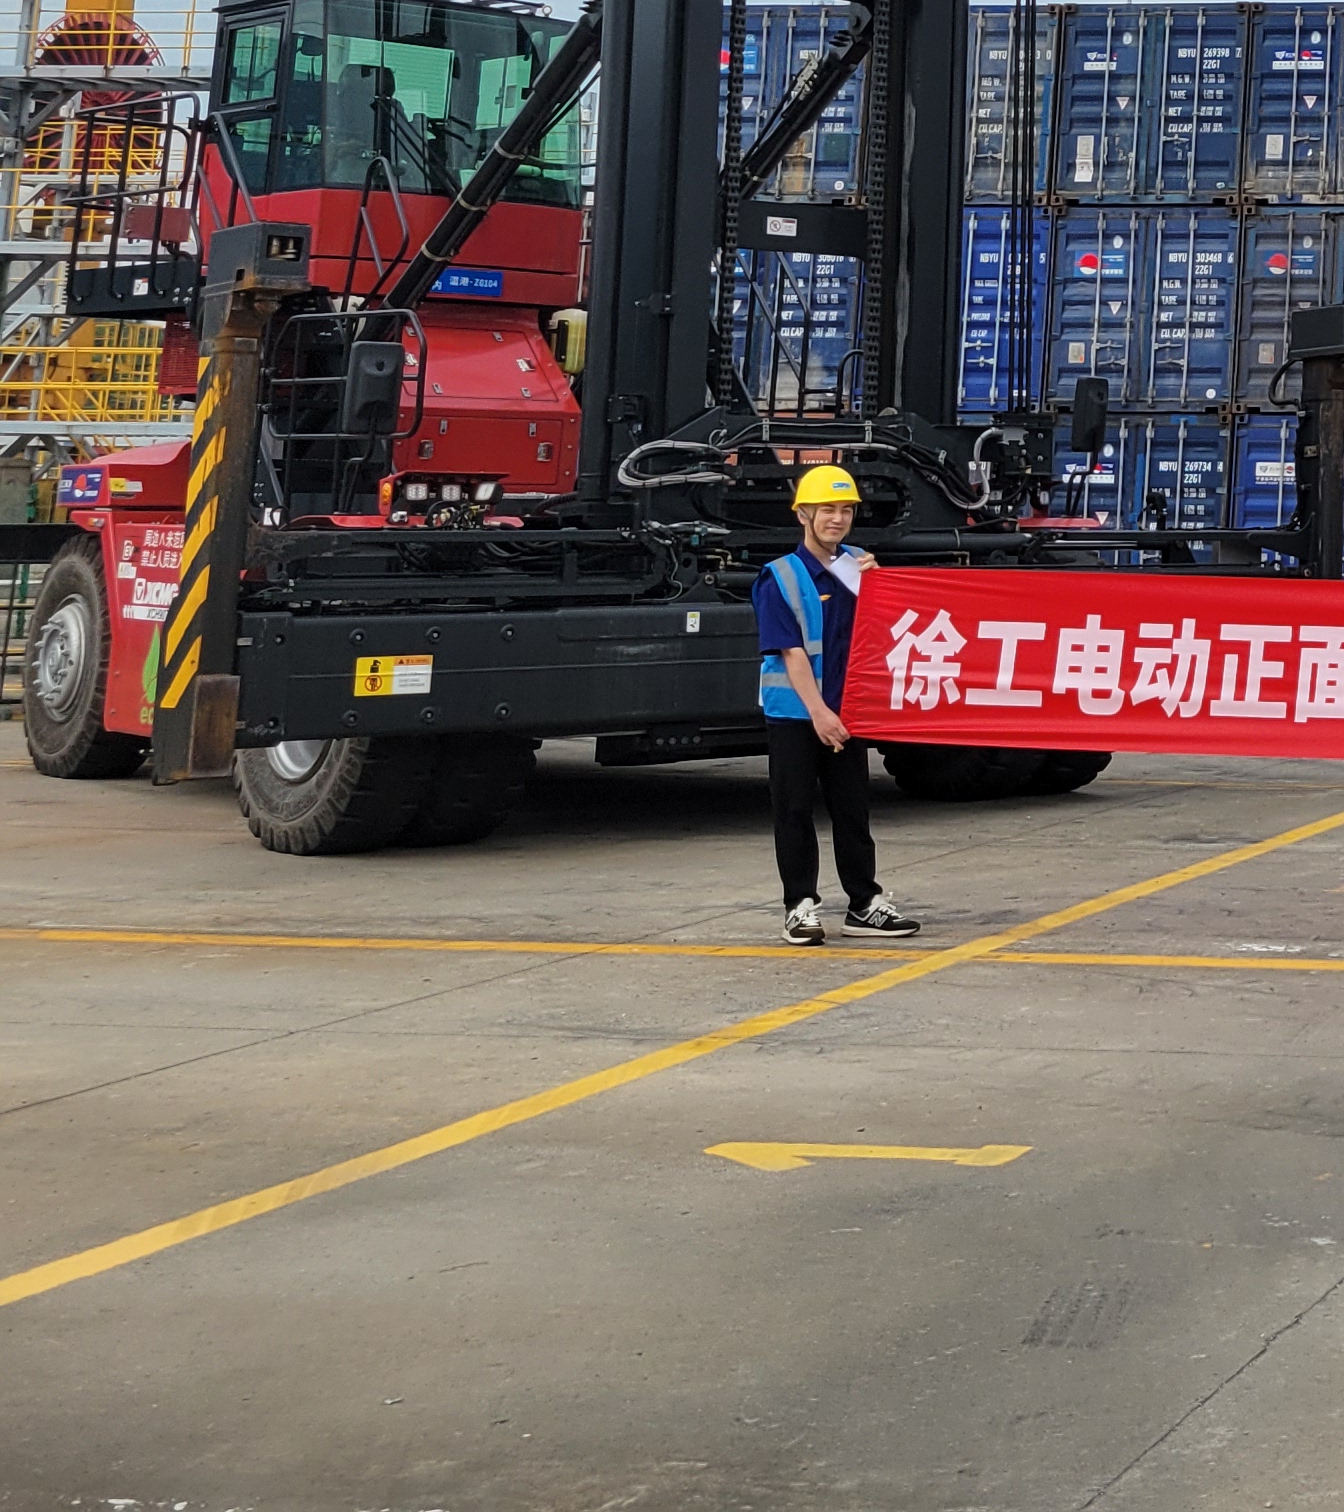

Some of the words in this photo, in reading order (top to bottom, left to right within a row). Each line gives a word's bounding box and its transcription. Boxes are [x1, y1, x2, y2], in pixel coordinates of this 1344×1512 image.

[1178, 48, 1196, 58] NBYU
[1203, 48, 1230, 58] 269398
[1203, 59, 1220, 69] 22G1
[980, 253, 999, 262] NBYU
[1169, 253, 1187, 262] NBYU
[1195, 253, 1222, 262] 303468
[1227, 252, 1234, 263] 6
[1195, 265, 1212, 275] 22G1
[1159, 461, 1177, 471] NBYU
[1184, 461, 1212, 472] 269734
[1183, 474, 1202, 484] 22G1
